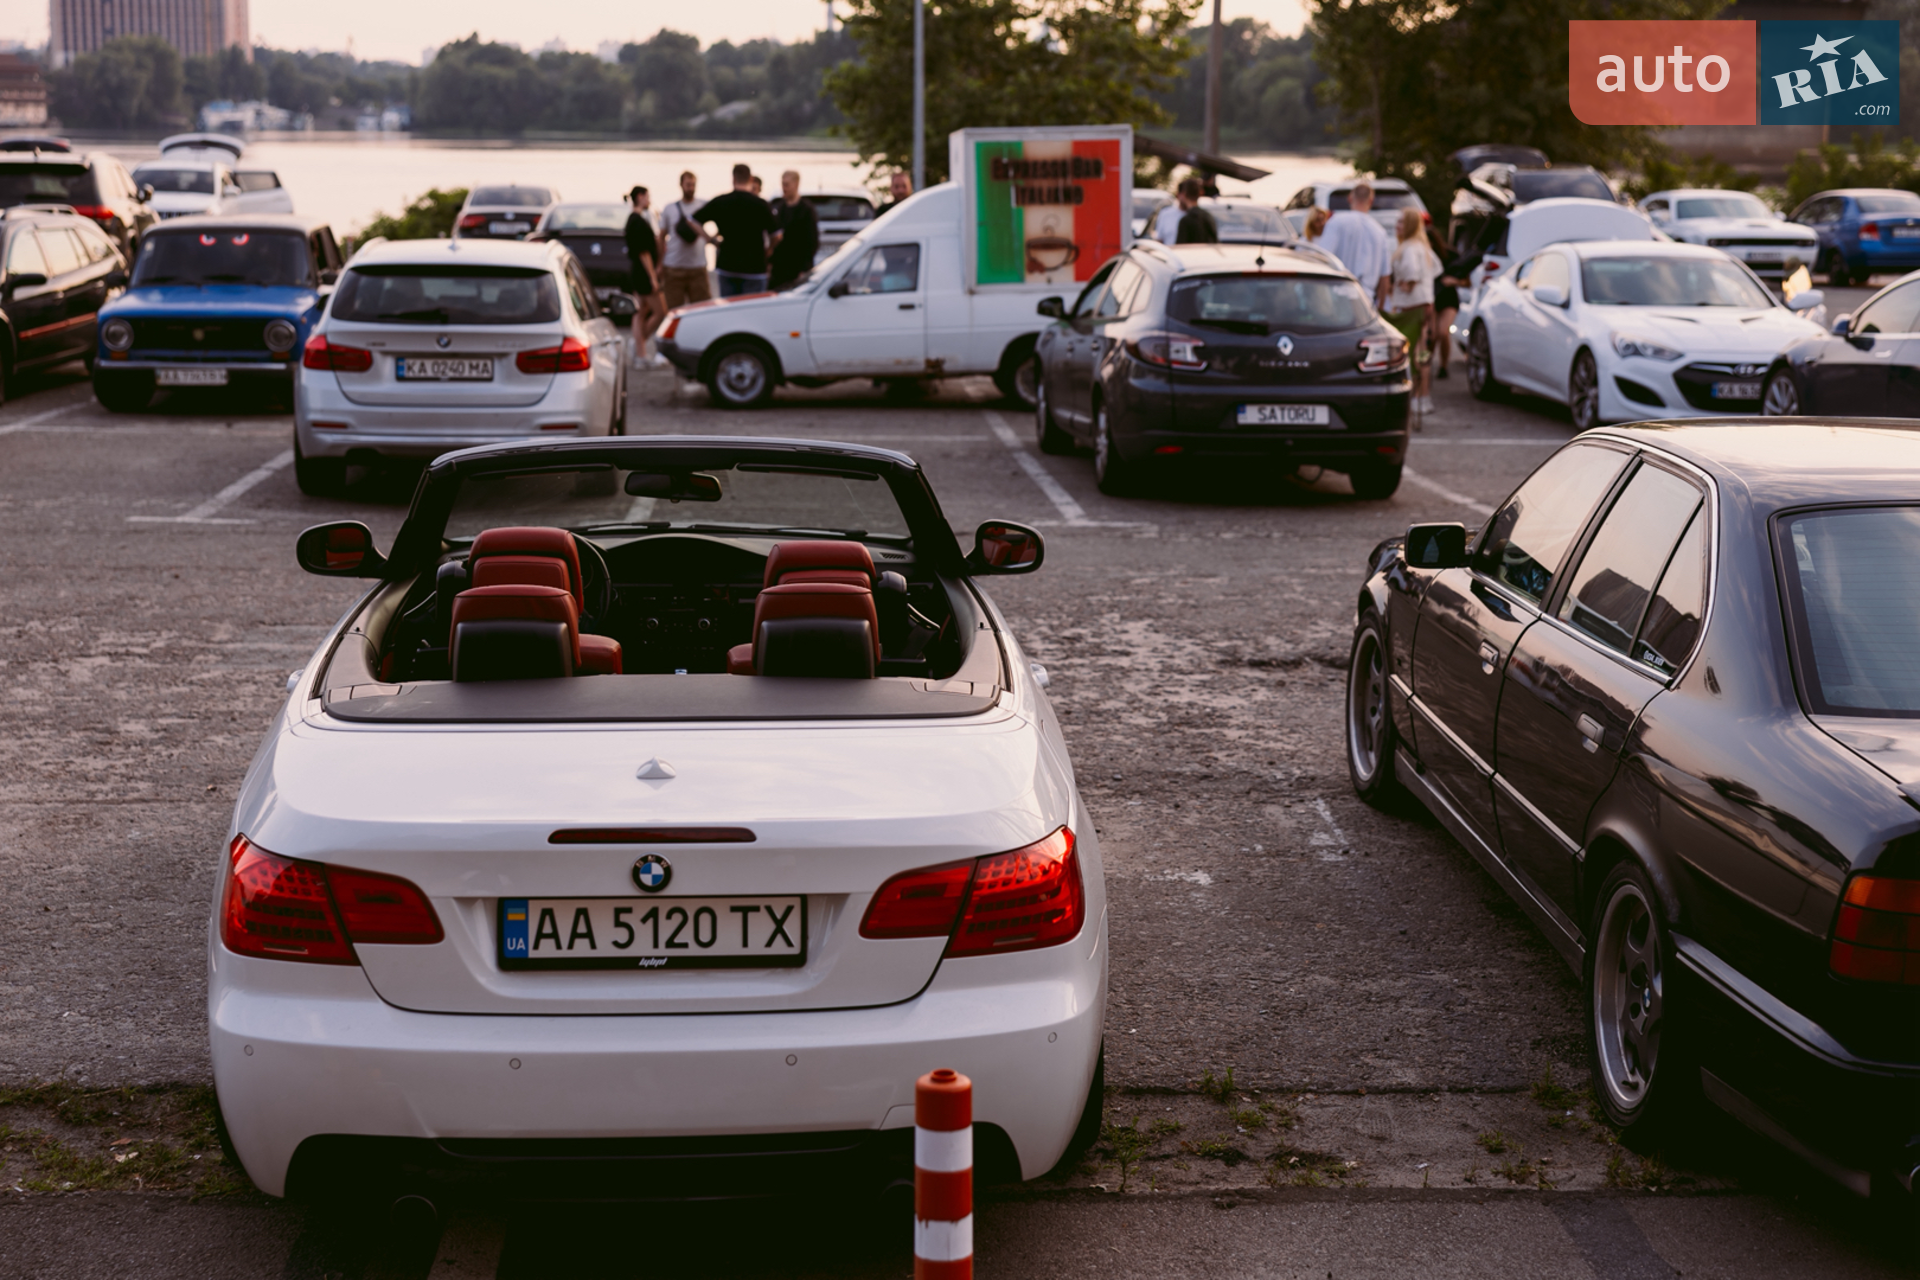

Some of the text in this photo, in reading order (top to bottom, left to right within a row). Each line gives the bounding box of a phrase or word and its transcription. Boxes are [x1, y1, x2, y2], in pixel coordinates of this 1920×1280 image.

[406, 360, 491, 375] KA 0240 MA
[1257, 406, 1316, 422] SATORU
[532, 905, 795, 950] AA 5120 TX
[506, 937, 526, 950] UA
